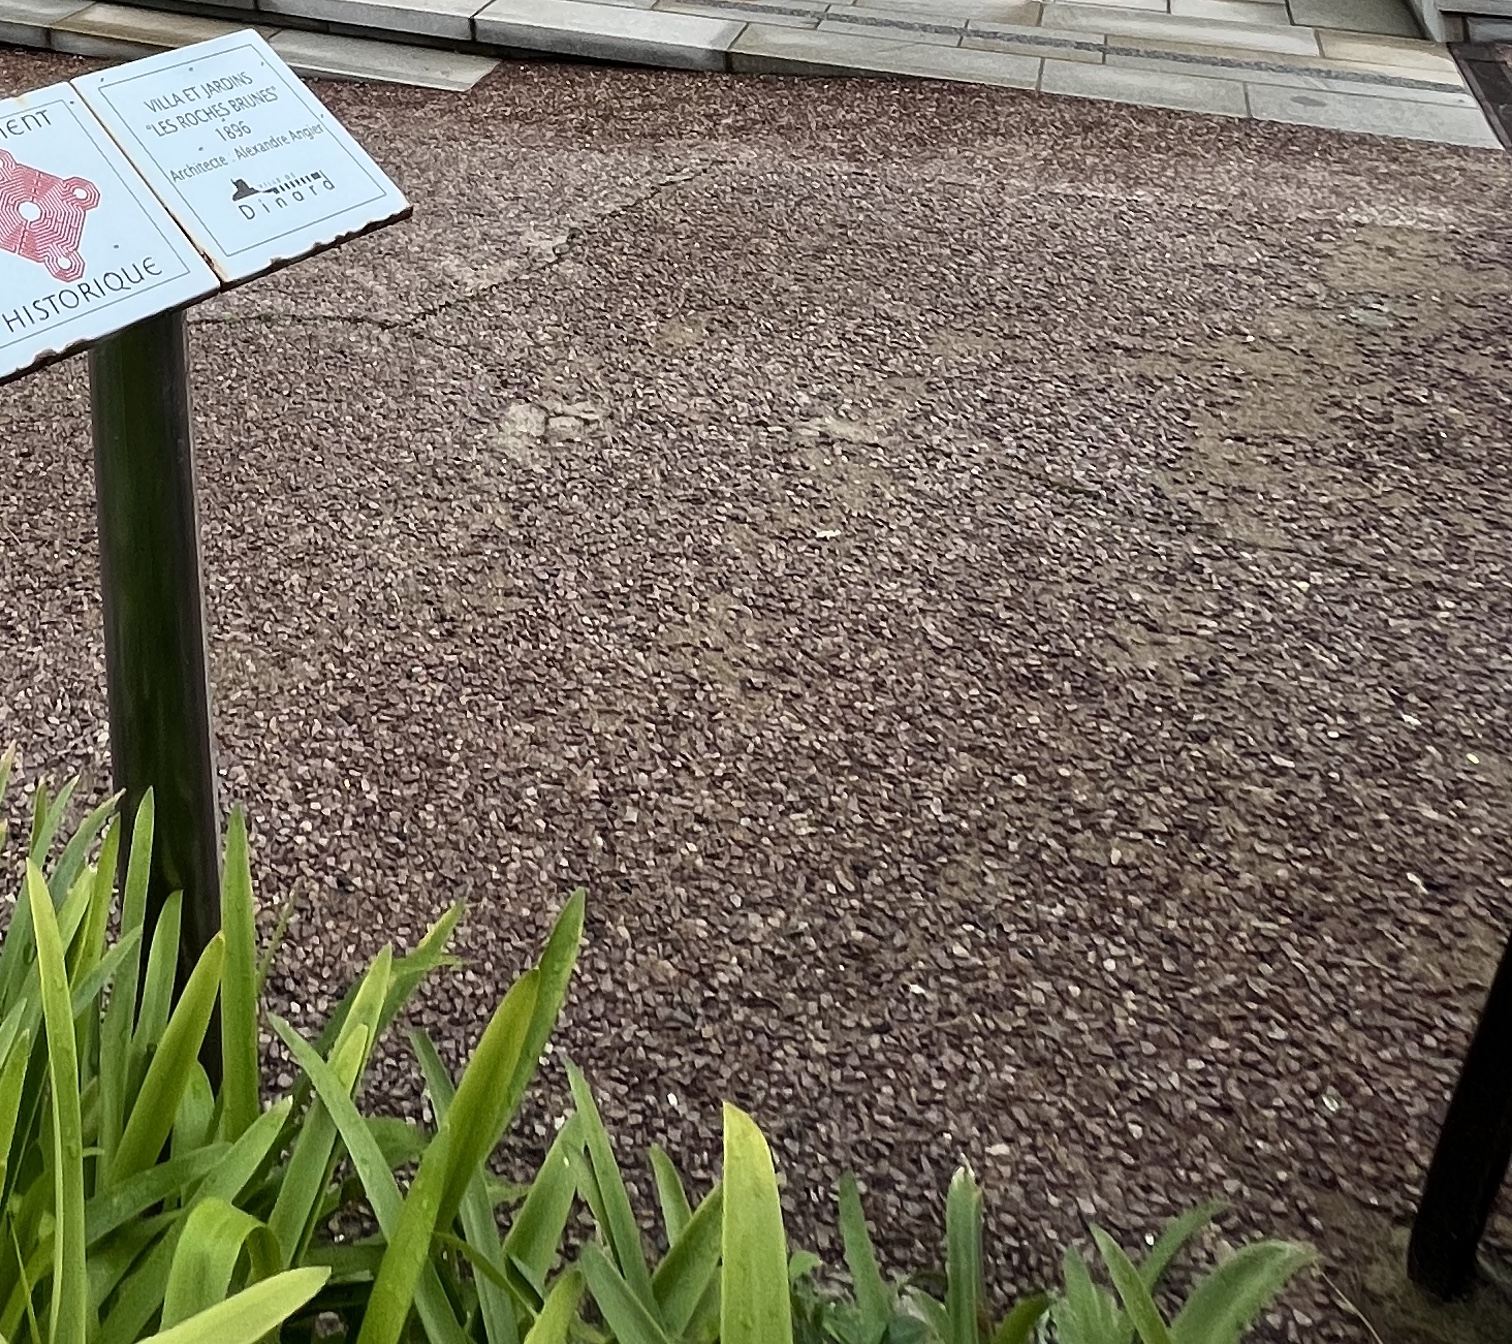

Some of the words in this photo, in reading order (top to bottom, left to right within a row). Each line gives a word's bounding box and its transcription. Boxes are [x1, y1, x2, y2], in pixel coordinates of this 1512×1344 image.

[144, 92, 185, 113] VILLA
[182, 86, 201, 102] ET
[200, 71, 253, 99] JARDINS
[176, 102, 231, 129] ROCHES
[215, 120, 252, 142] 1896
[169, 153, 228, 183] Architecte
[233, 135, 290, 161] Alexandre
[288, 122, 324, 142] Angier
[238, 170, 335, 220] Dinard
[1, 257, 163, 333] HISTORIQUE
